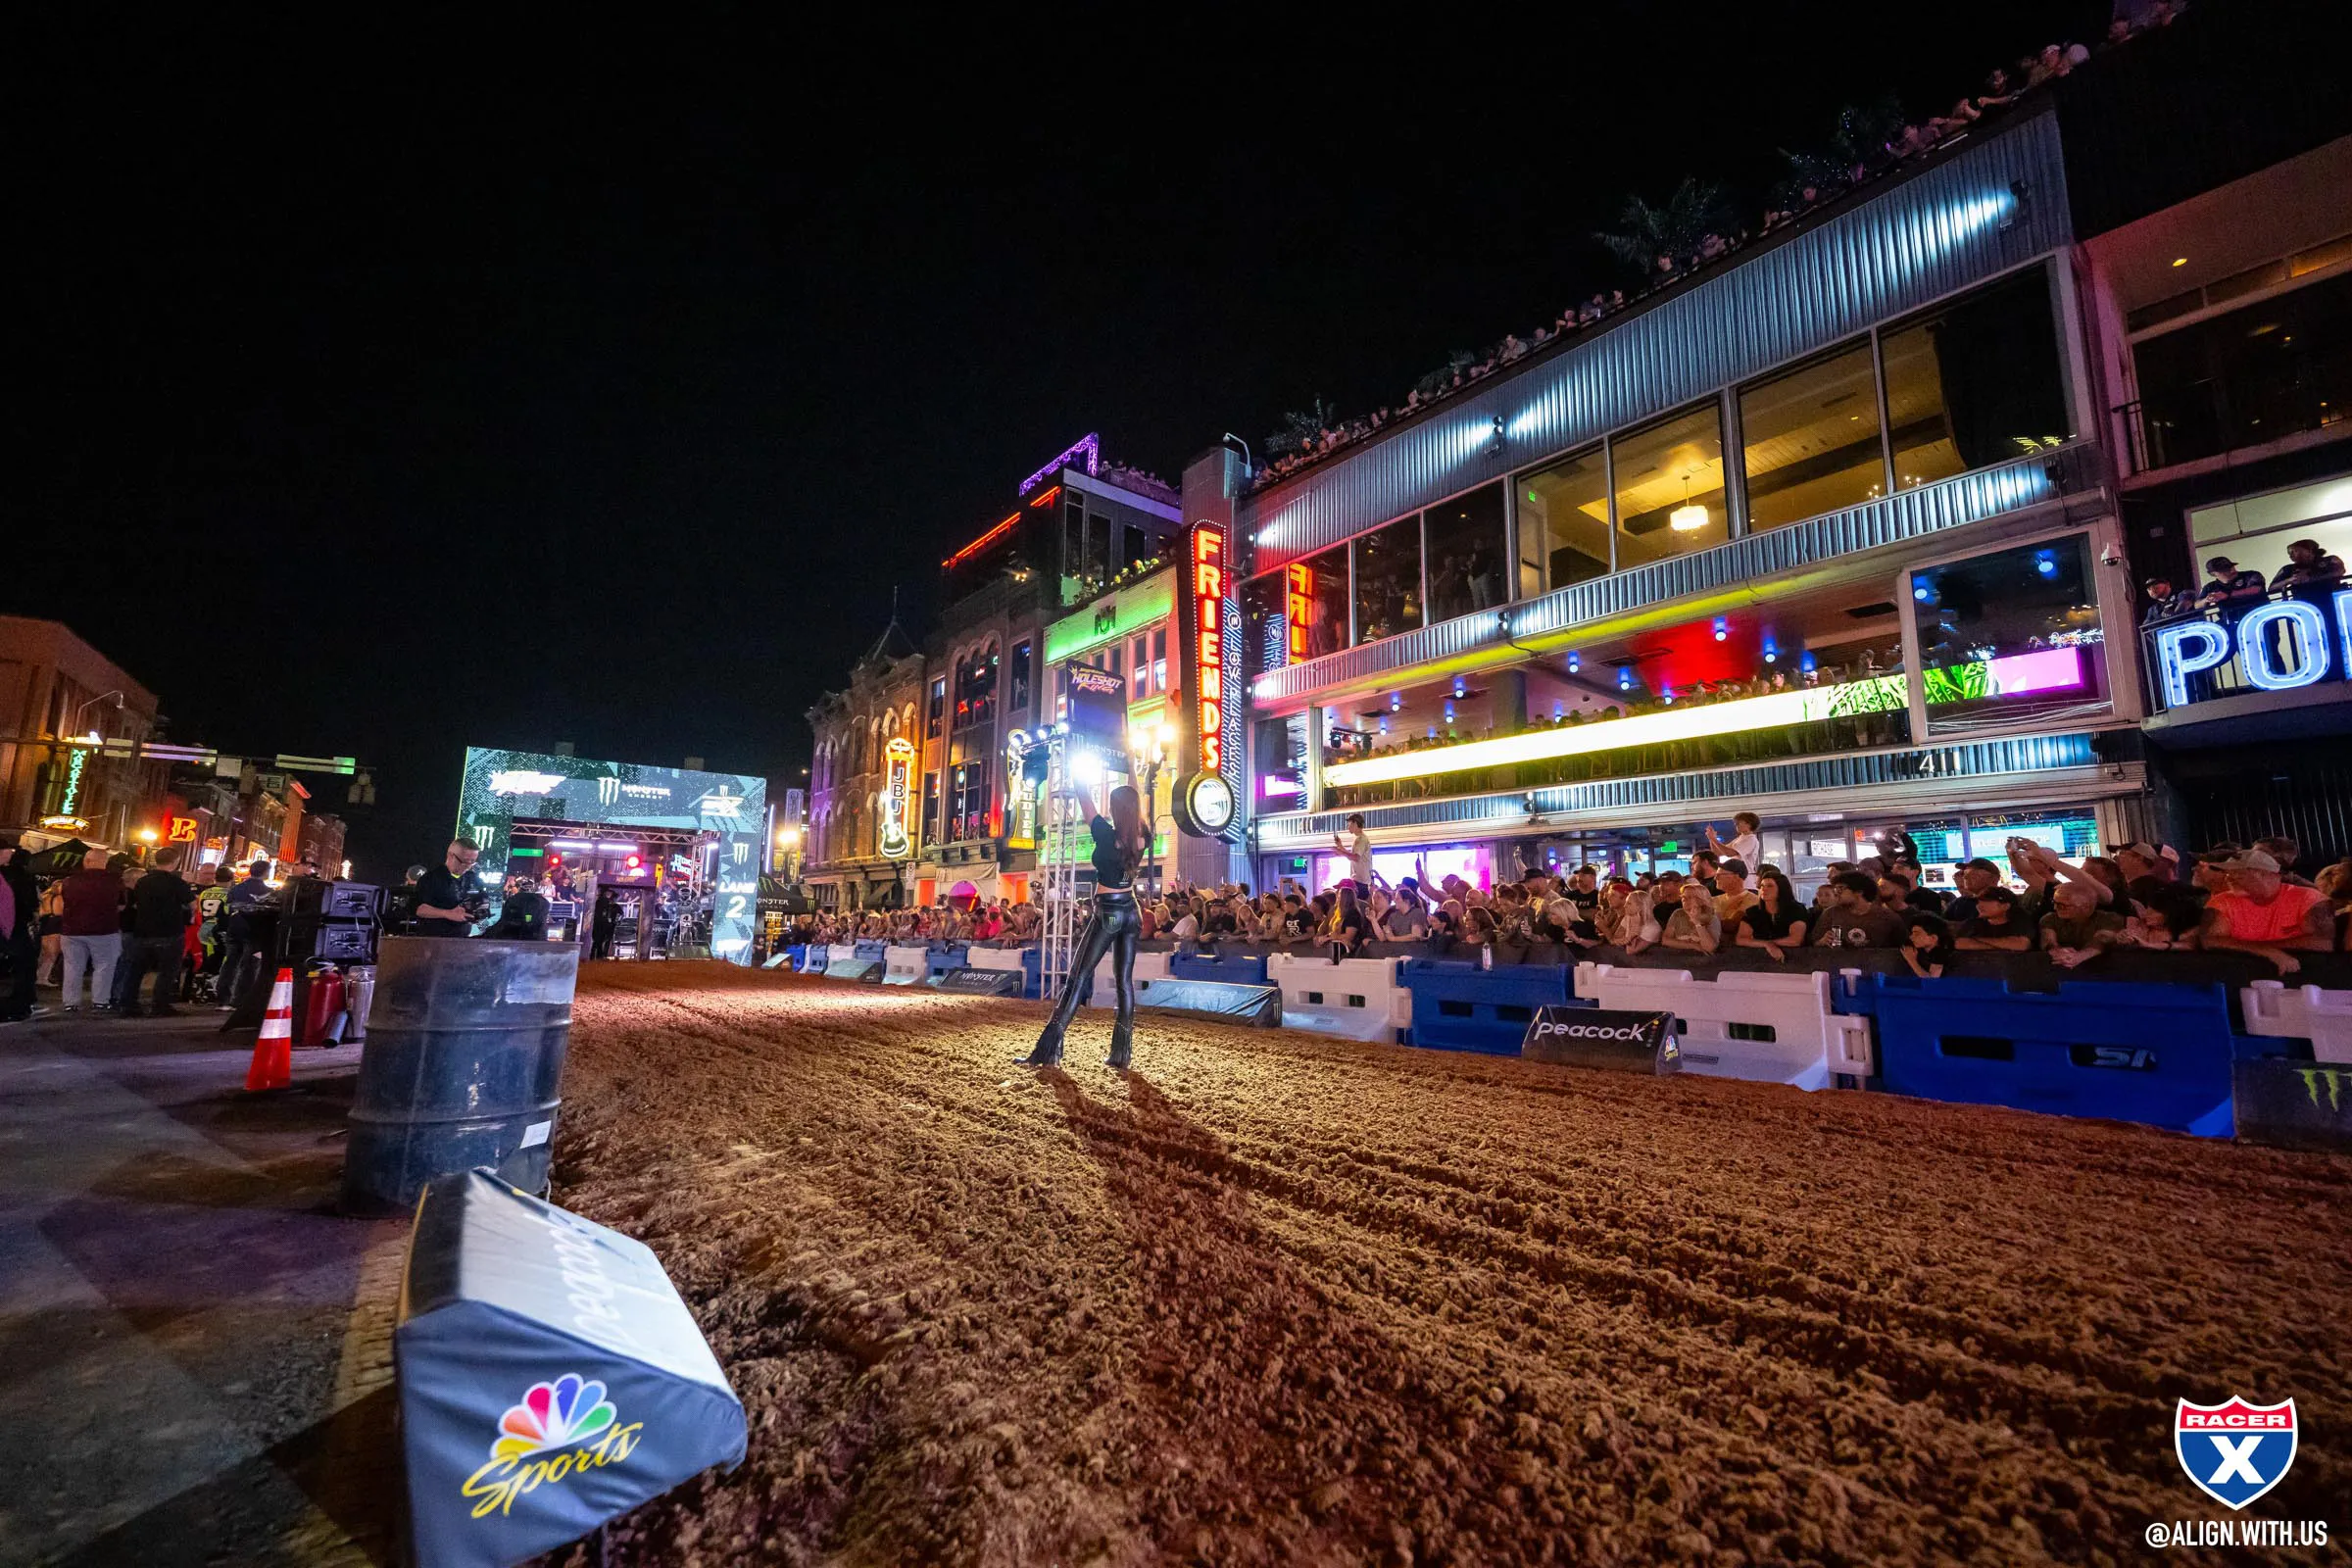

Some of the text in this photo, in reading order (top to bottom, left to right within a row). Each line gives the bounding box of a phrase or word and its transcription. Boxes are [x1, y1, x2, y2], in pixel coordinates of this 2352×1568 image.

[1198, 529, 1221, 768] FRIENDS
[2156, 590, 2352, 708] PO
[1072, 673, 1123, 688] HOLESHOT
[1228, 615, 1241, 776] IN LOW PLACES
[1919, 751, 1960, 775] 411
[621, 784, 671, 797] MONSTER
[718, 882, 757, 894] LANE
[725, 895, 747, 918] 2
[756, 897, 789, 906] ONSTER
[1534, 1019, 1645, 1043] peacock
[462, 1422, 643, 1519] Sports
